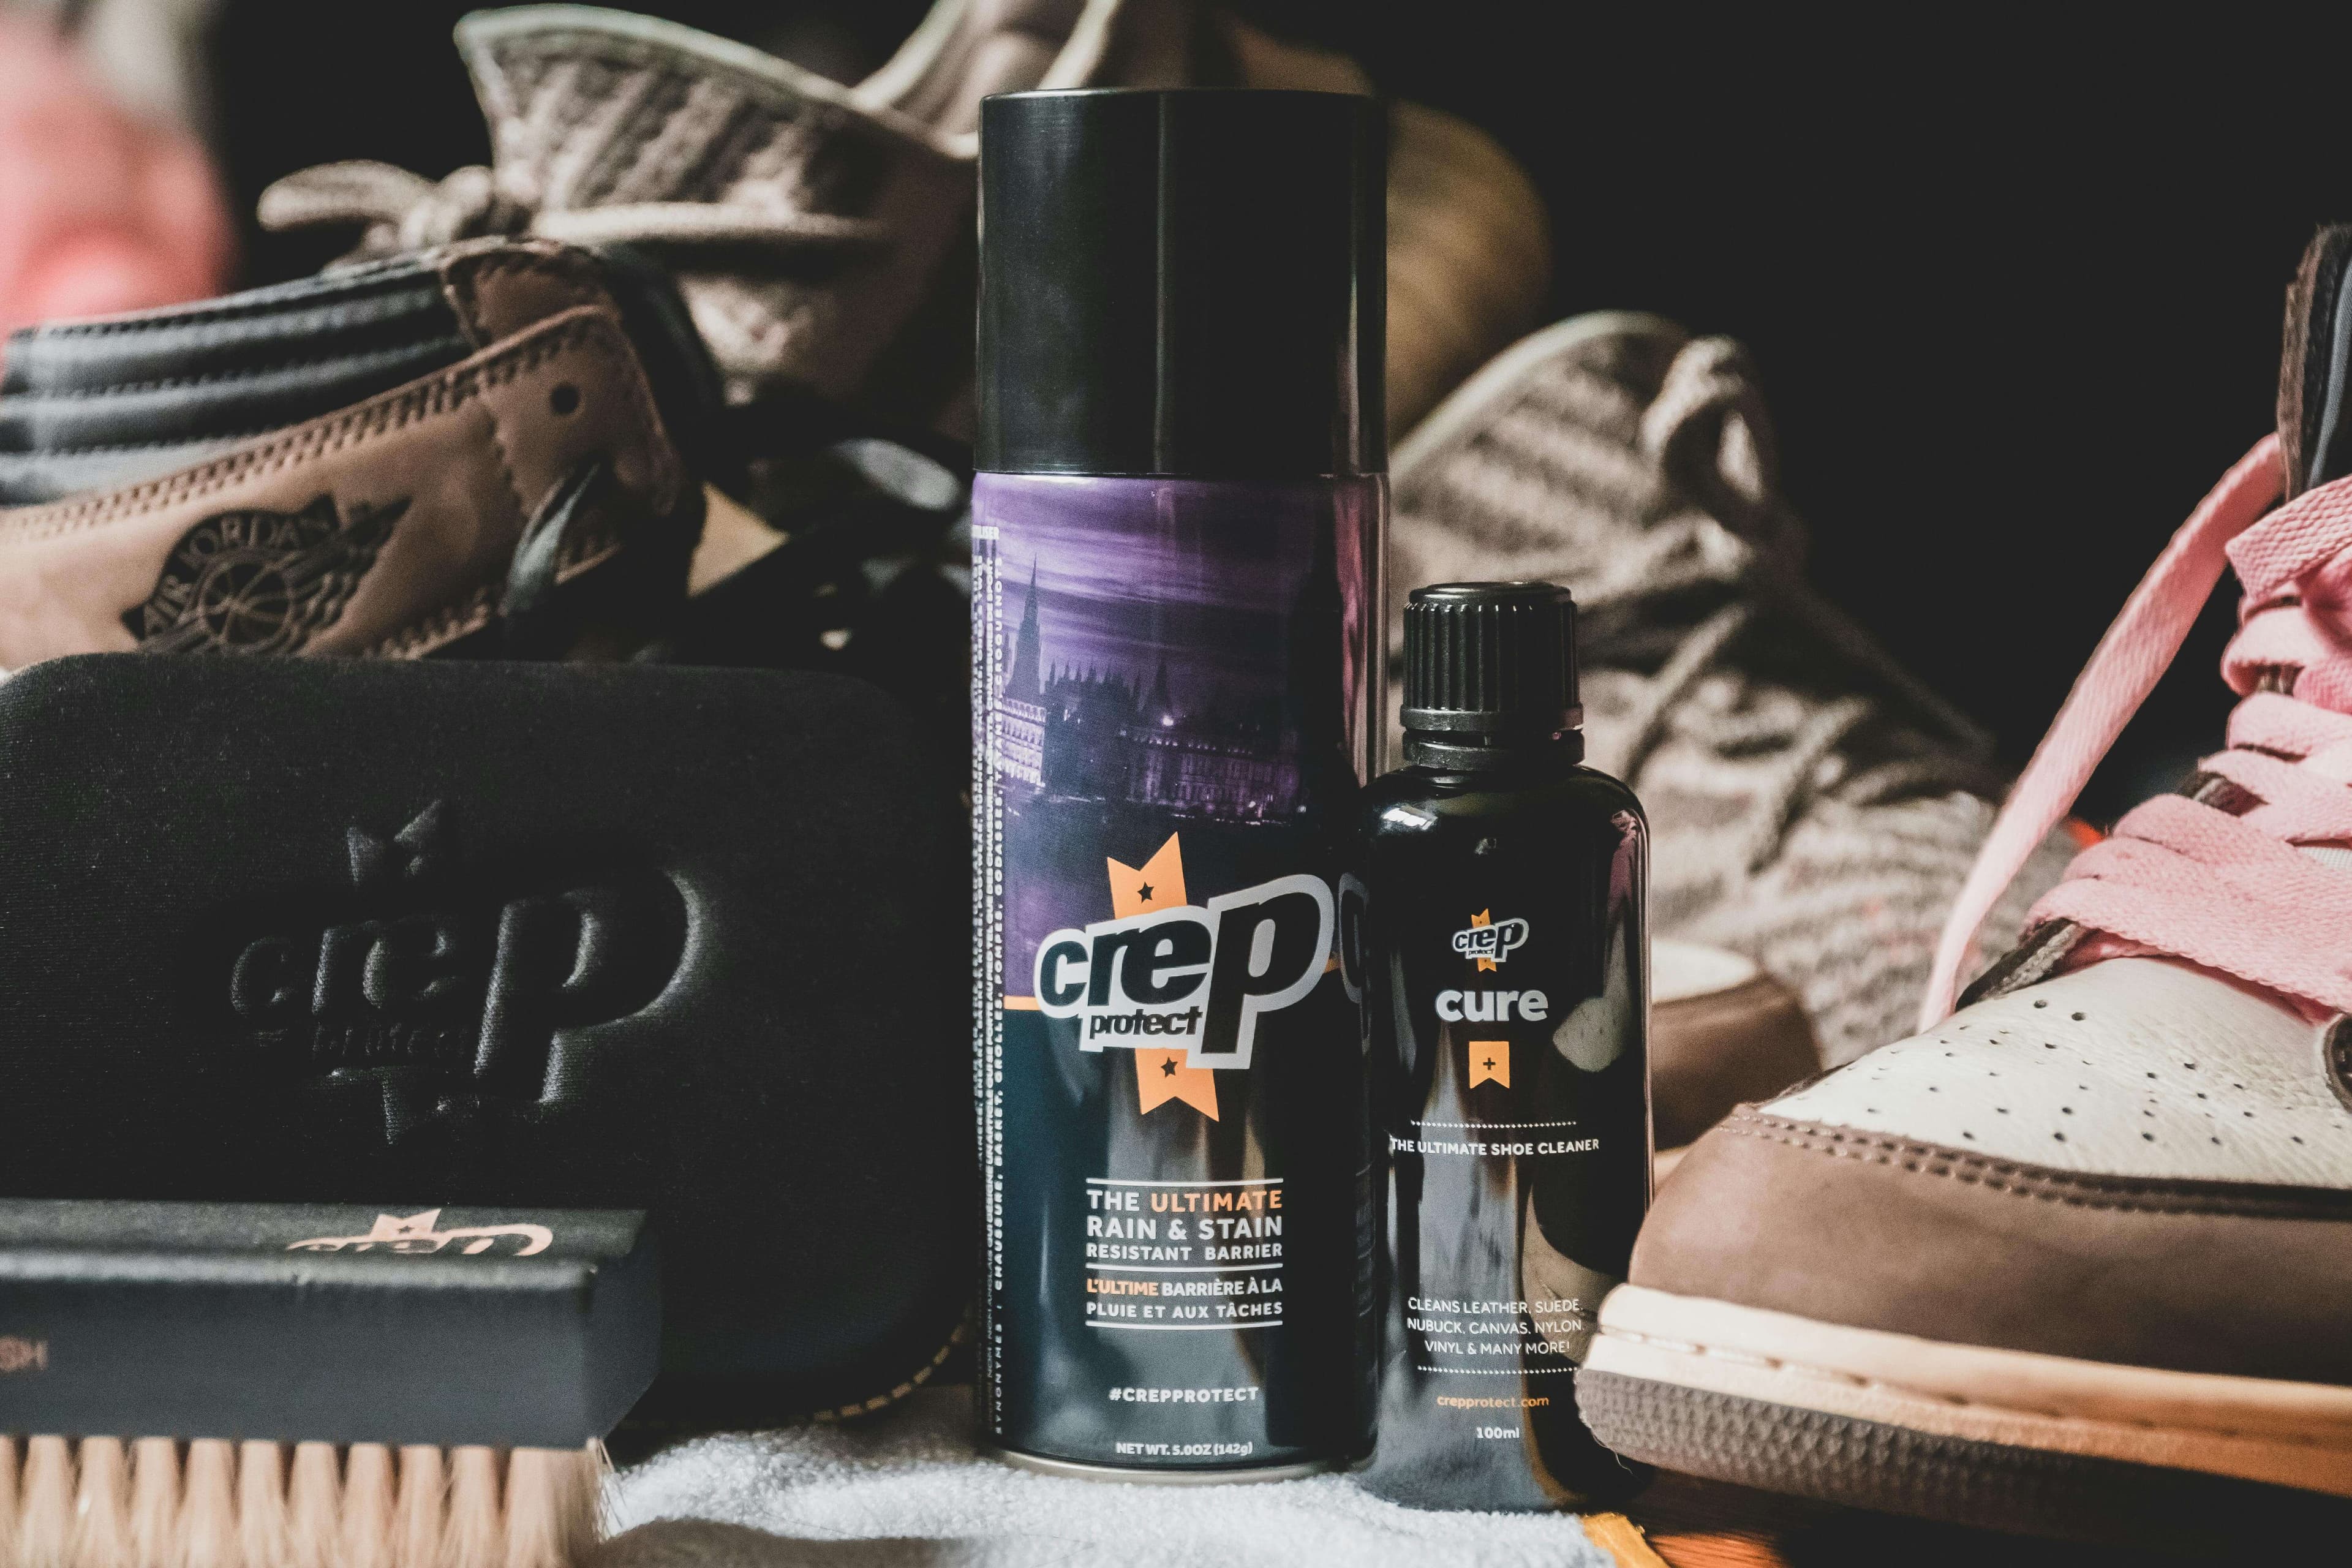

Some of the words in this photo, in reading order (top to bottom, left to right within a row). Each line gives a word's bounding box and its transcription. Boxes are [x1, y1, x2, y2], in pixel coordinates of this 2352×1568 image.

[144, 573, 194, 641] AIR
[1453, 921, 1526, 959] crep
[1468, 948, 1494, 956] protect
[1039, 889, 1322, 1055] crep
[1435, 989, 1548, 1022] cure
[1090, 1006, 1203, 1039] protect
[1390, 1137, 1415, 1153] THE
[1417, 1140, 1487, 1155] ULTIMATE
[1491, 1143, 1534, 1156] SHOE
[1537, 1139, 1600, 1154] CLEANER
[1087, 1189, 1140, 1212] THE
[1151, 1189, 1283, 1213] ULTIMATE
[1087, 1215, 1156, 1239] RAIN
[1168, 1219, 1187, 1240] &
[1198, 1215, 1283, 1240] STAIN
[1087, 1242, 1193, 1261] RESISTANT
[1205, 1243, 1283, 1261] BARRIER
[1163, 1278, 1244, 1297] BARRIÈRE
[1247, 1275, 1261, 1294] À
[1262, 1279, 1283, 1293] LA
[1086, 1302, 1137, 1317] PLUIE
[1144, 1304, 1166, 1318] ET
[1172, 1305, 1209, 1319] AUX
[1216, 1302, 1283, 1318] TÂCHES
[1408, 1297, 1461, 1313] CLEANS
[1424, 1340, 1464, 1354] VINYL
[1467, 1343, 1477, 1355] &
[1480, 1343, 1522, 1355] MANY
[1525, 1341, 1570, 1354] MORE!
[1109, 1387, 1259, 1403] #CREPPROTECT
[1436, 1395, 1550, 1409] crepprotect.com
[1476, 1427, 1520, 1439] 100ml
[1116, 1442, 1144, 1455] NET
[1145, 1444, 1170, 1455] WT.
[1213, 1442, 1253, 1456] (142g)
